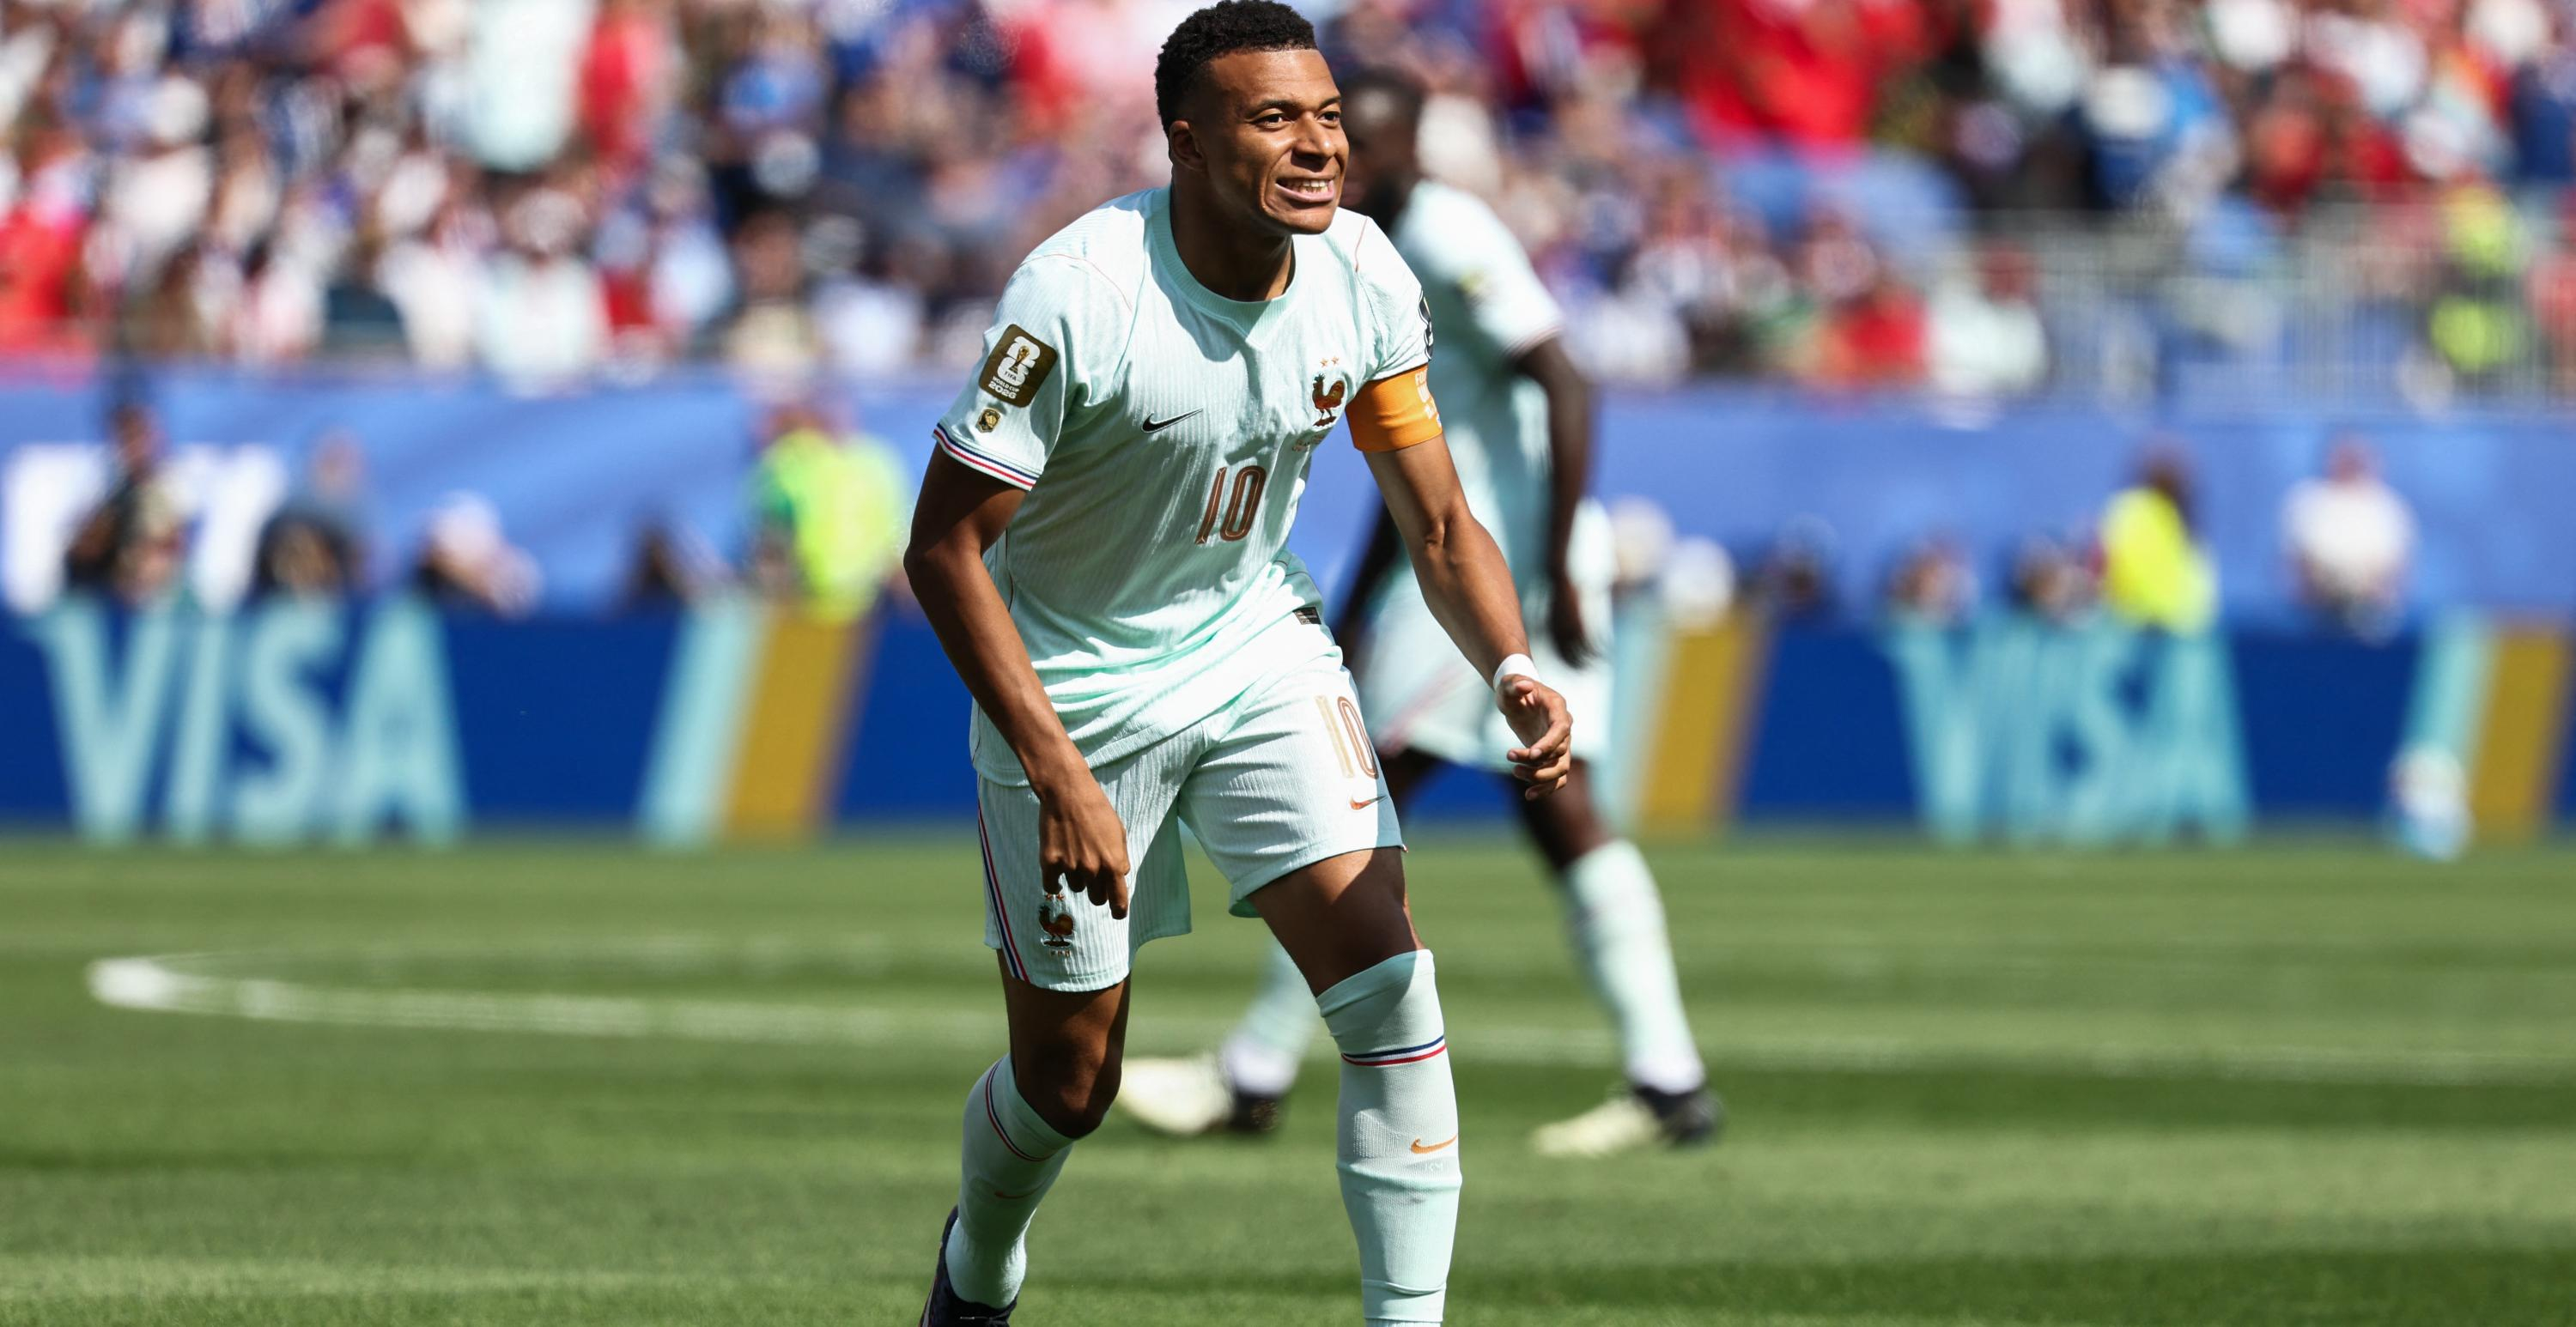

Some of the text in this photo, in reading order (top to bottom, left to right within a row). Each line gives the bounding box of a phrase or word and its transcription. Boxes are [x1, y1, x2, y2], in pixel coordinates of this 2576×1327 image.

[988, 380, 1018, 399] 2026
[992, 375, 1010, 389] WORLD
[1004, 371, 1018, 381] FIFA
[1194, 464, 1267, 544] 10
[30, 594, 471, 845] VISA
[1315, 694, 1379, 780] 10
[1885, 611, 2251, 845] VISA
